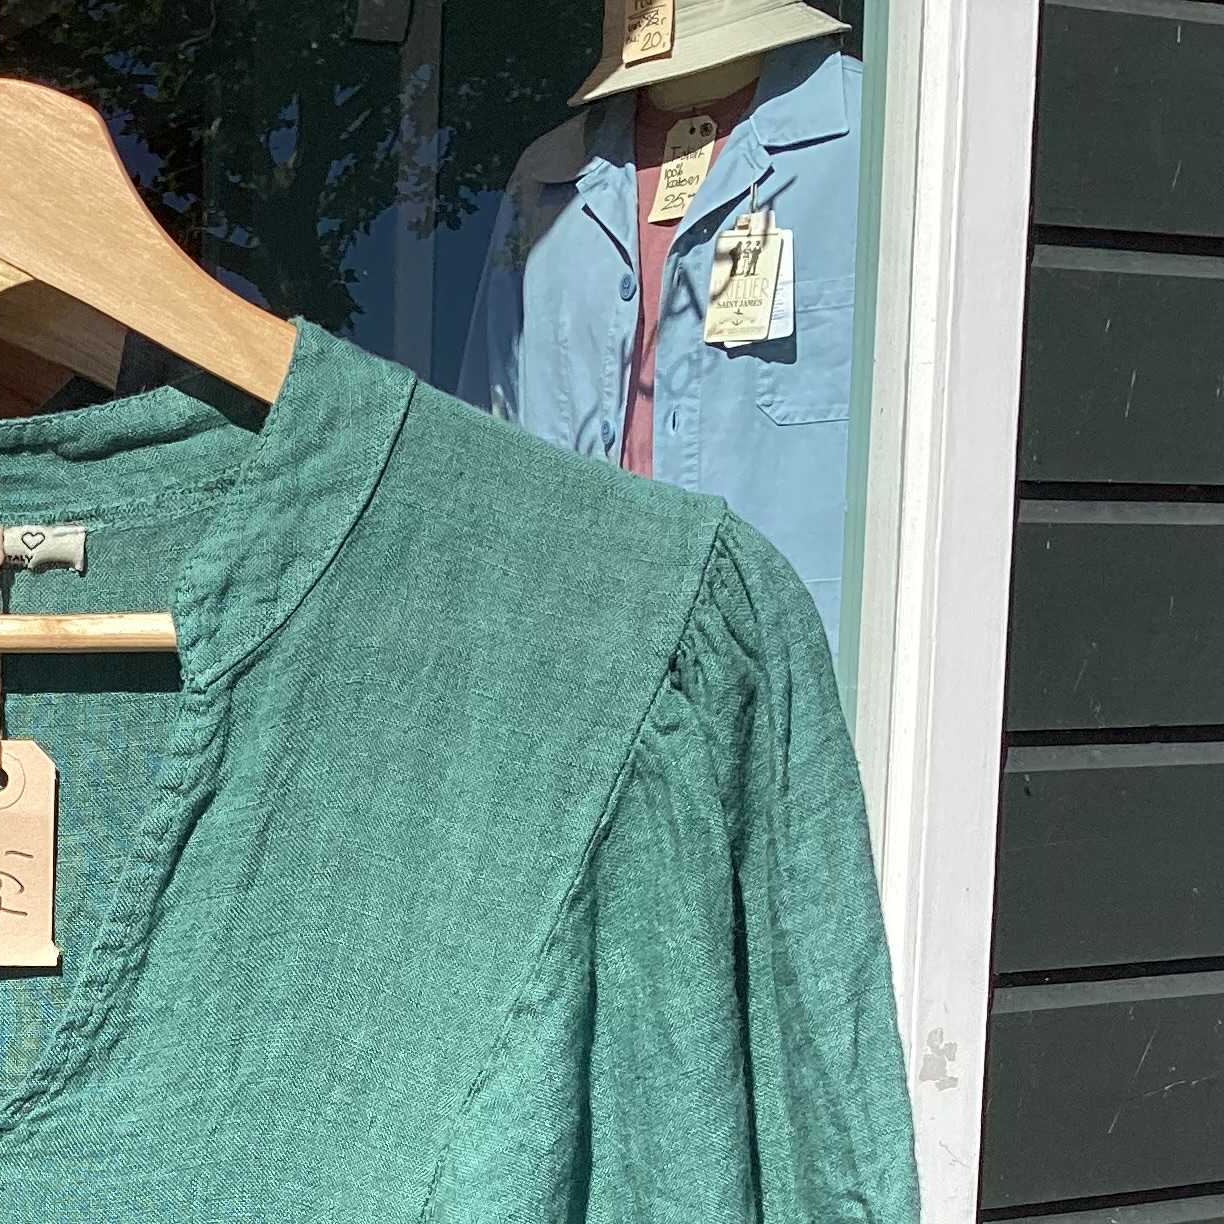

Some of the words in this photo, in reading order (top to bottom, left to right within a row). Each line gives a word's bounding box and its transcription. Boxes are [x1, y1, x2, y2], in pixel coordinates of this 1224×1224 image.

[664, 162, 684, 181] 100%
[716, 300, 738, 309] SAINT
[739, 299, 763, 308] JAMES
[5, 554, 34, 563] TALY
